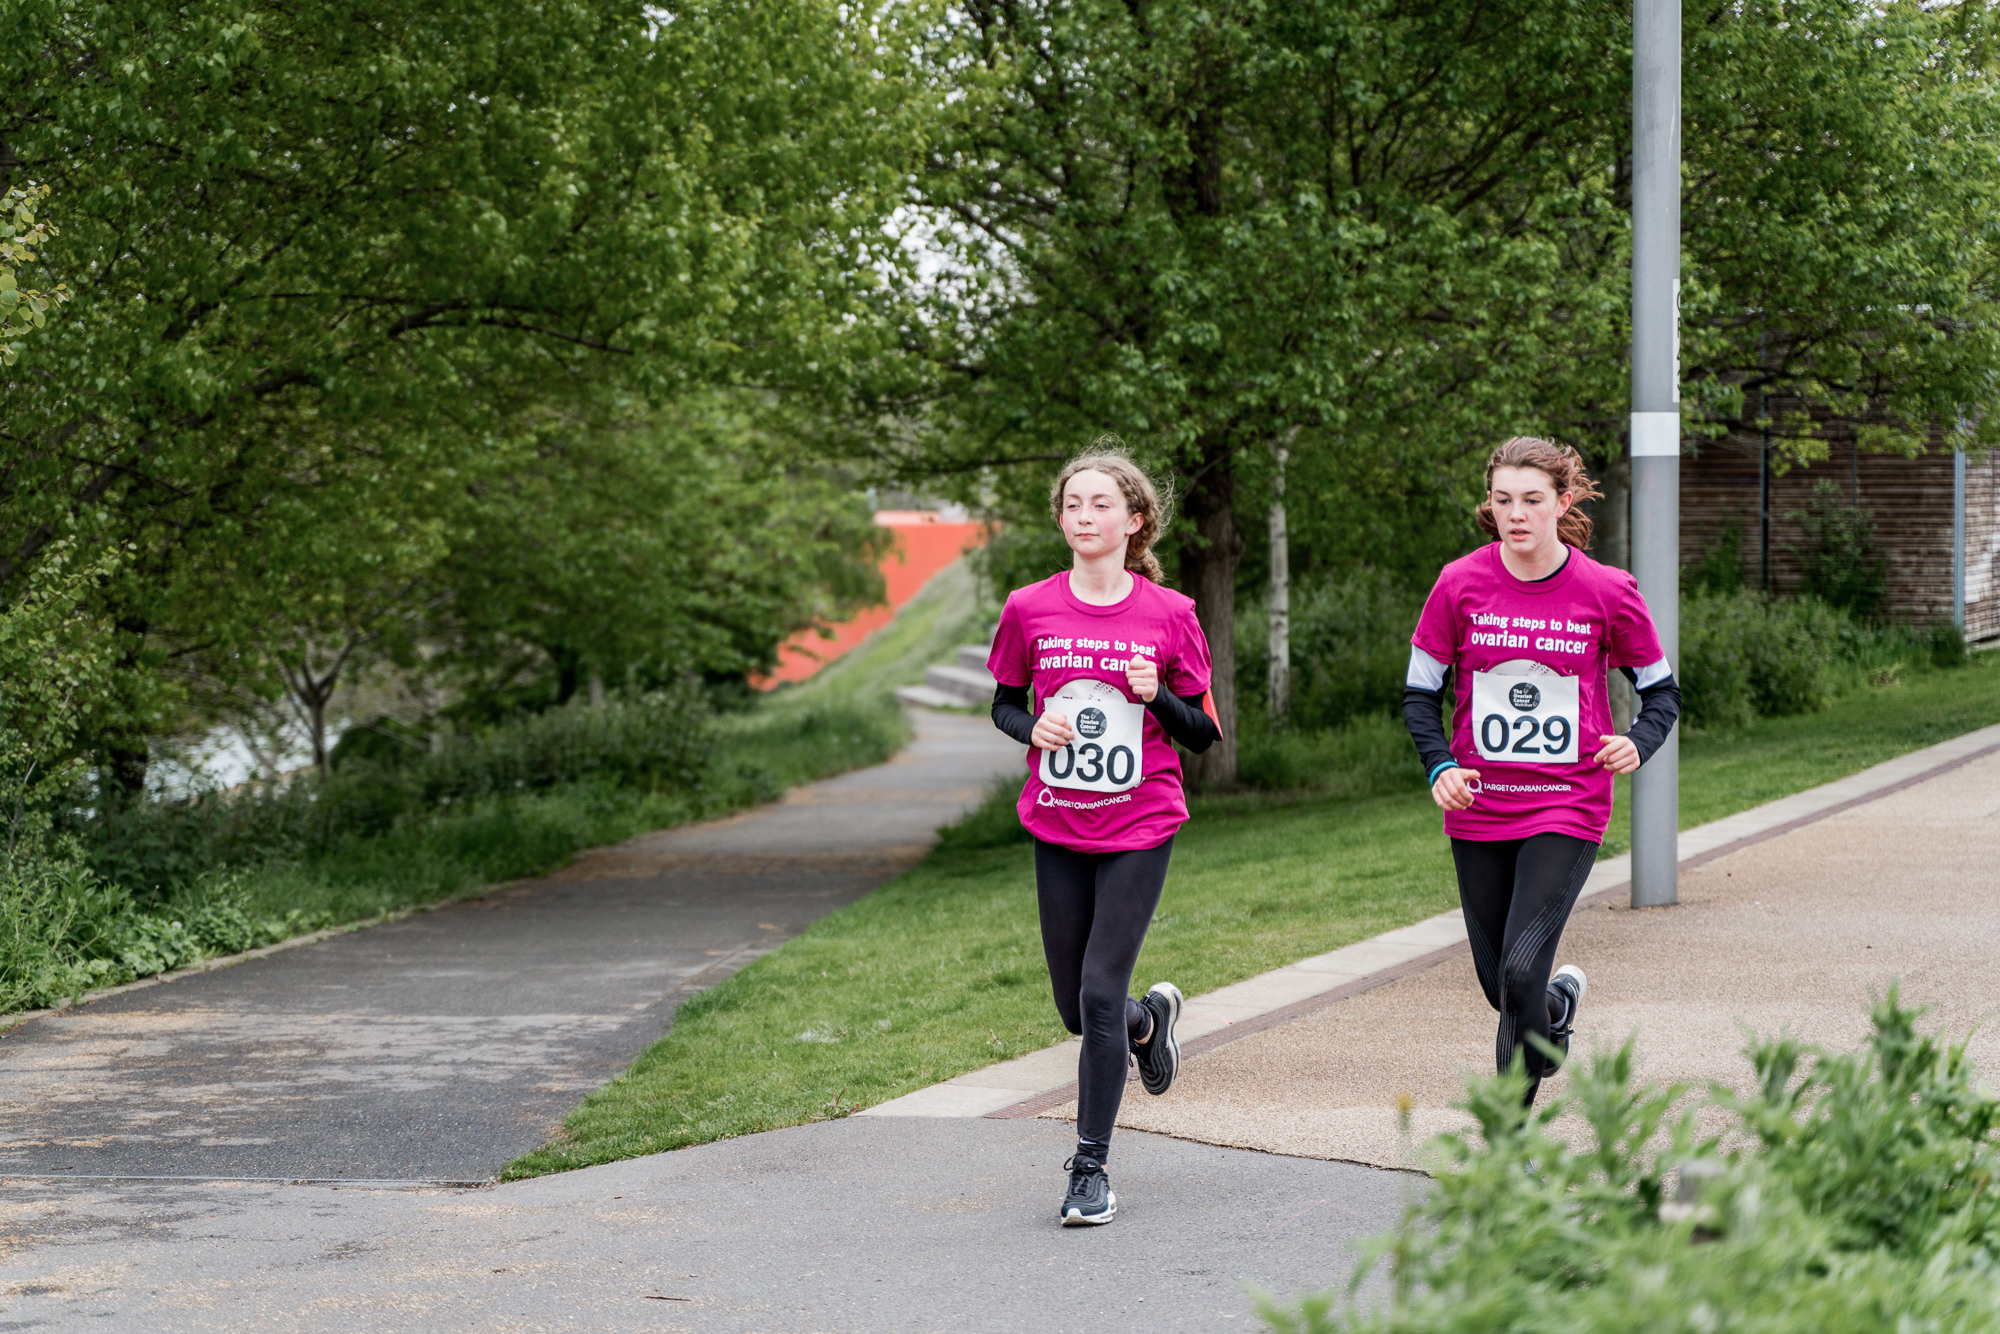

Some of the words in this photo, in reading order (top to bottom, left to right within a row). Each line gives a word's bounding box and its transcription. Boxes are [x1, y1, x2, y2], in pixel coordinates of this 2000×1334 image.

[1470, 613, 1509, 628] Taking
[1512, 616, 1546, 631] steps
[1550, 619, 1562, 631] to
[1566, 619, 1591, 634] beat
[1037, 636, 1073, 650] Taking
[1076, 637, 1110, 651] steps
[1114, 640, 1127, 651] to
[1131, 641, 1156, 657] beat
[1471, 630, 1529, 648] ovarian
[1535, 637, 1588, 654] cancer
[1040, 651, 1093, 670] ovarian
[1100, 657, 1130, 672] can
[1481, 713, 1571, 755] 029
[1048, 742, 1135, 785] 030
[1484, 783, 1509, 792] TARGET
[1510, 784, 1541, 792] OVARIAN
[1542, 784, 1572, 792] CANCER
[1074, 800, 1104, 810] OVARIAN
[1104, 794, 1132, 806] CANCER
